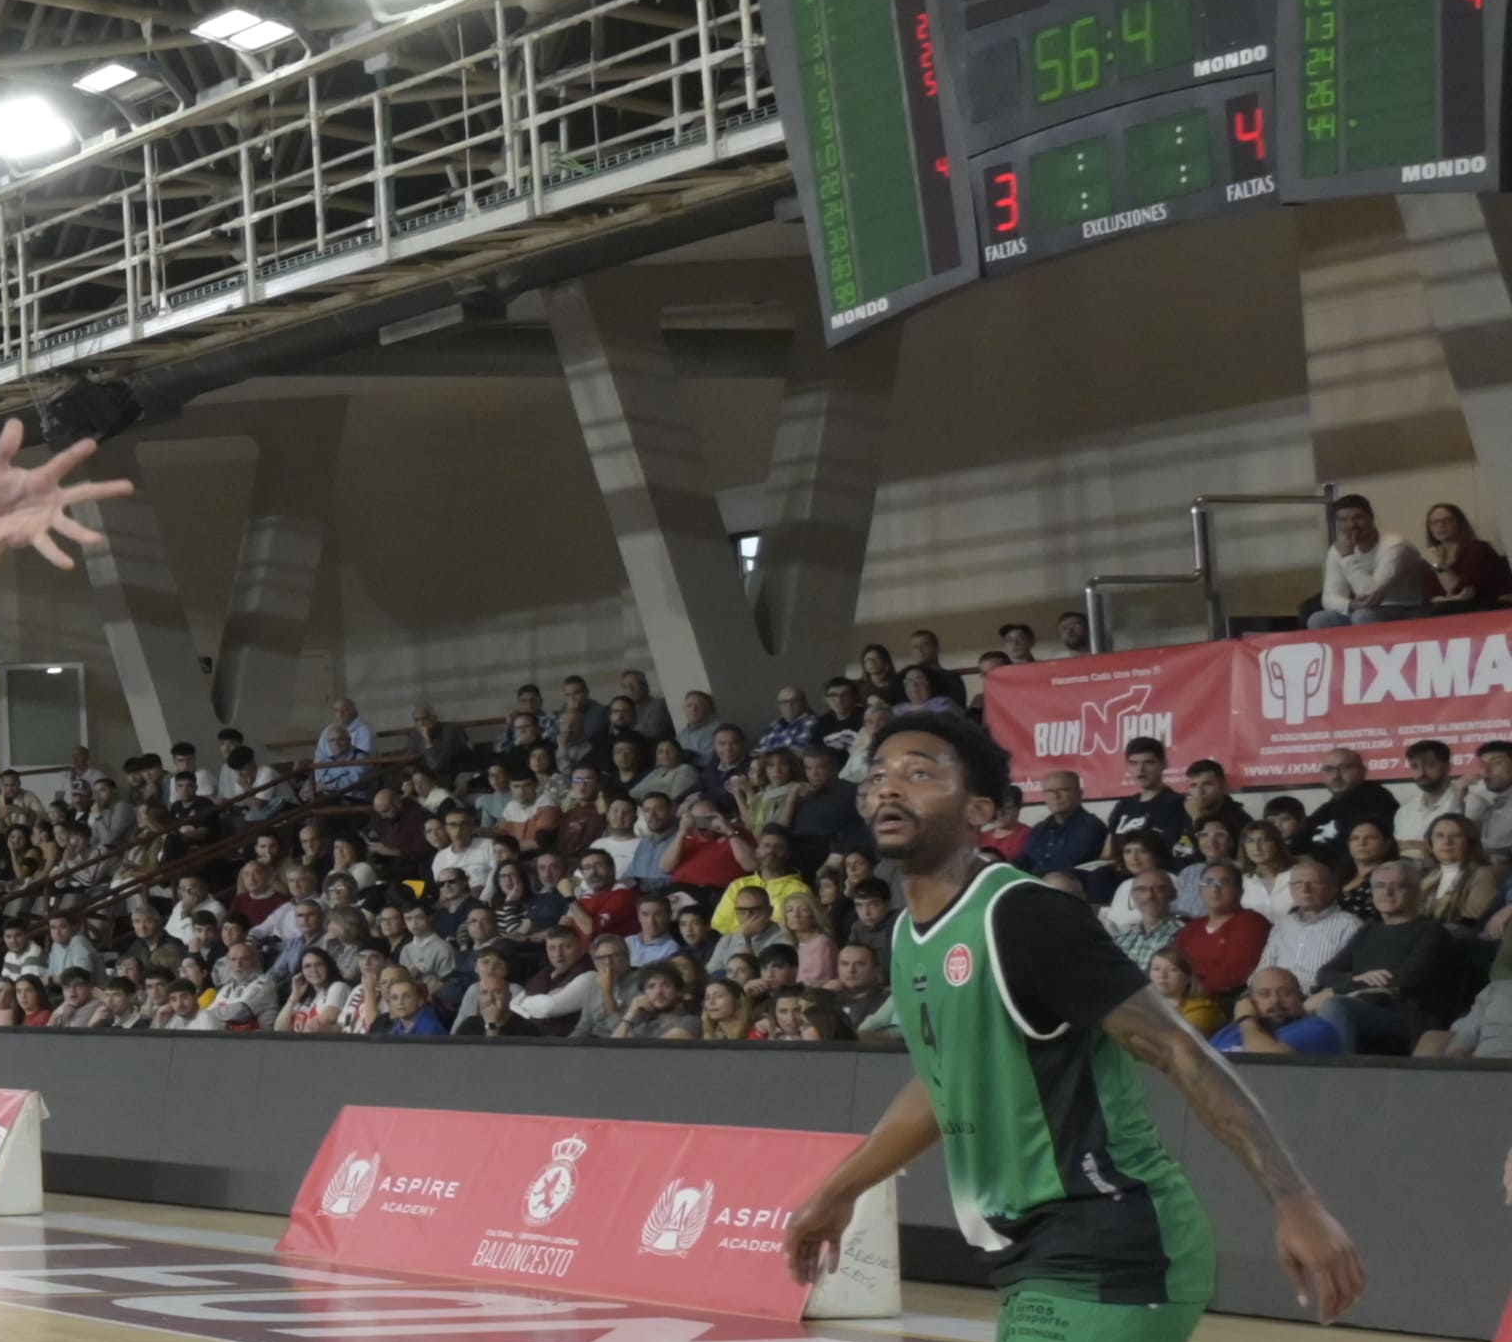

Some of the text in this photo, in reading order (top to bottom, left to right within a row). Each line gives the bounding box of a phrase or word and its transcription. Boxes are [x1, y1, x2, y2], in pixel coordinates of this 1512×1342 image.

[1183, 44, 1269, 78] MONDO
[1233, 106, 1268, 161] 4
[1399, 155, 1488, 183] MONDO
[993, 171, 1021, 233] 3
[1225, 174, 1276, 203] FALTAS
[1081, 202, 1169, 239] EXCLUSIONES
[984, 236, 1028, 263] FALTAS
[830, 296, 890, 330] MONDO
[379, 1176, 460, 1200] ASPIRE
[379, 1201, 438, 1217] ACADEMY
[472, 1239, 574, 1278] BALONCESTO
[717, 1236, 784, 1253] ACADEM
